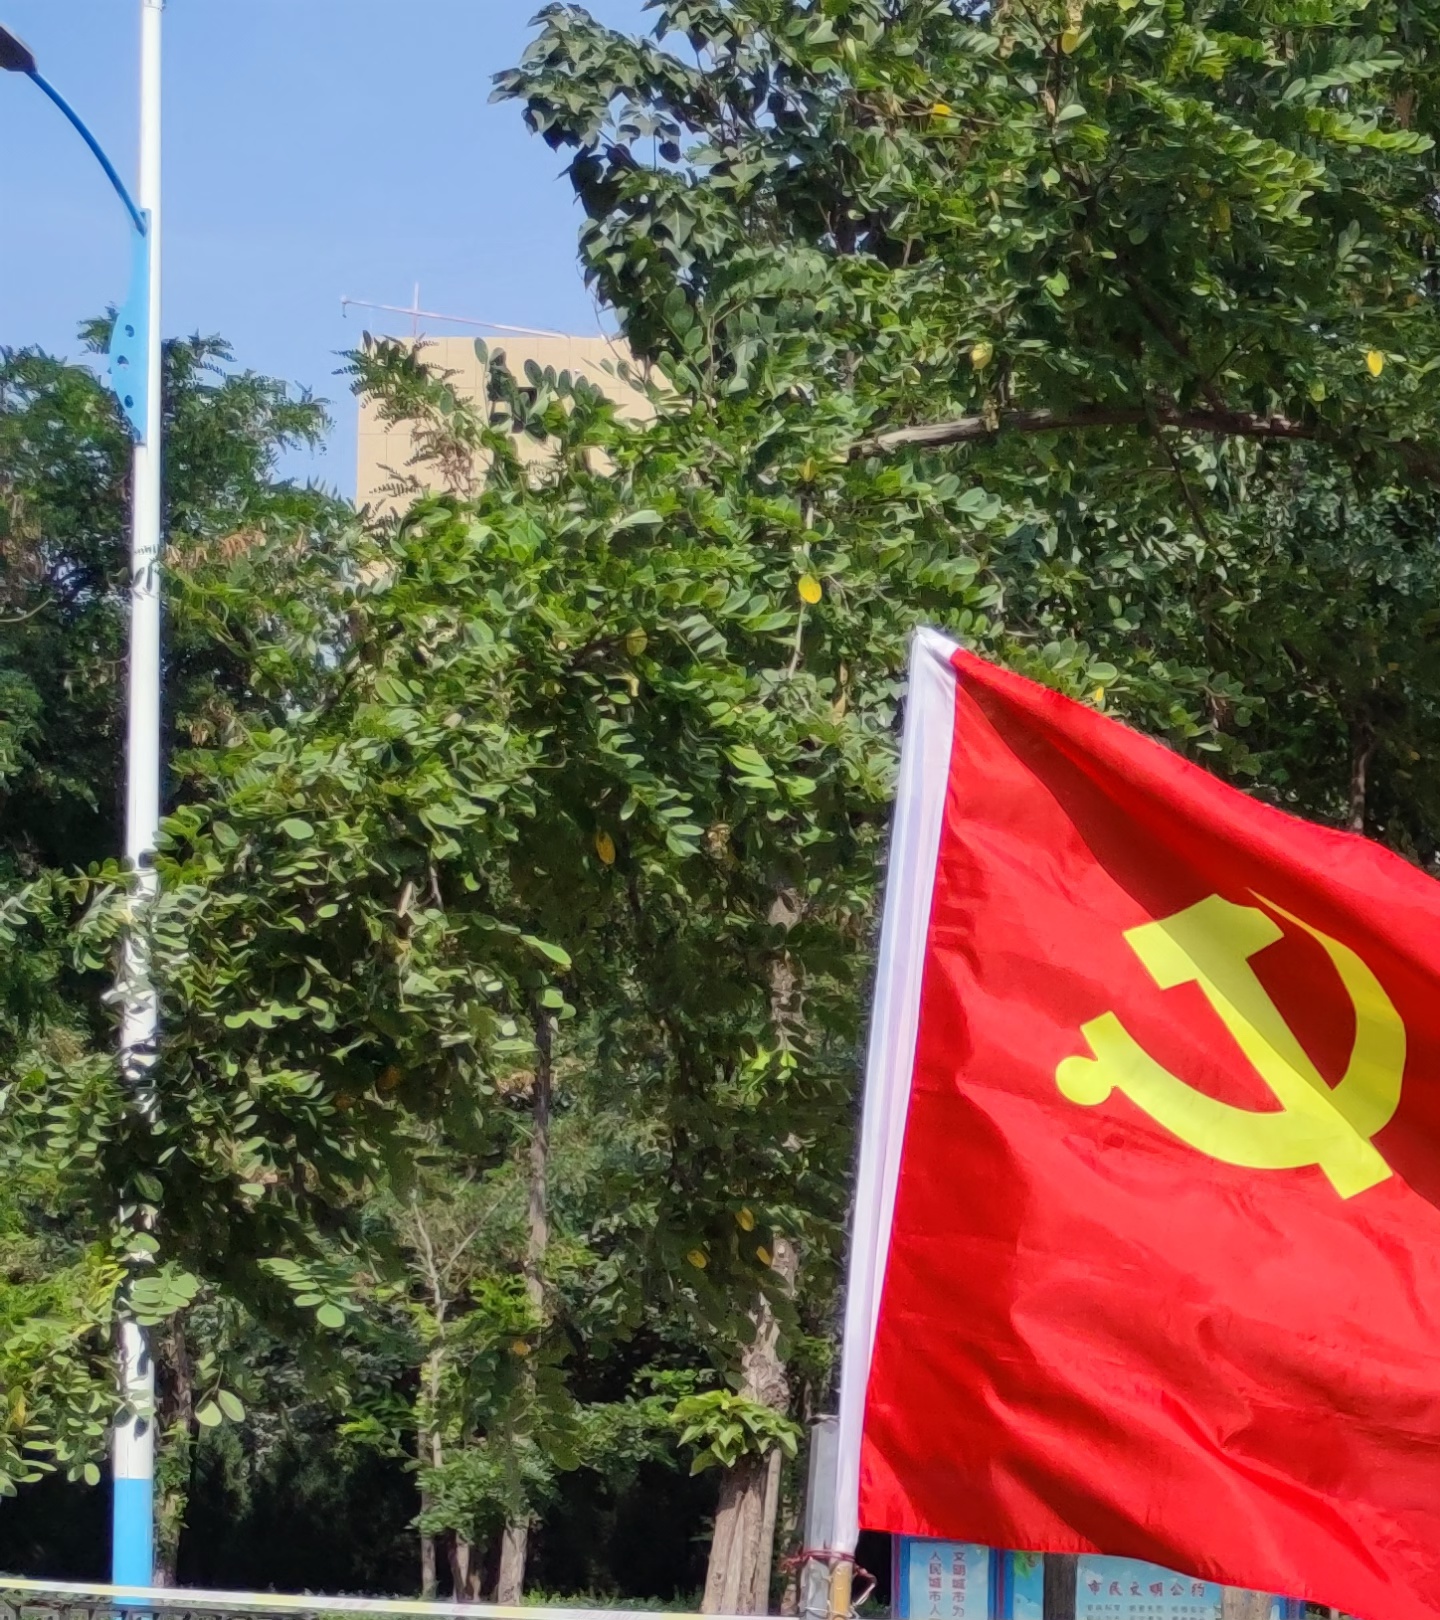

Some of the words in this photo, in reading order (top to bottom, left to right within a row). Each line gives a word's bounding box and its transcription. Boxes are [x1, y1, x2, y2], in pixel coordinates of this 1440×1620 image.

[1087, 1579, 1206, 1598] 市民文明公约
